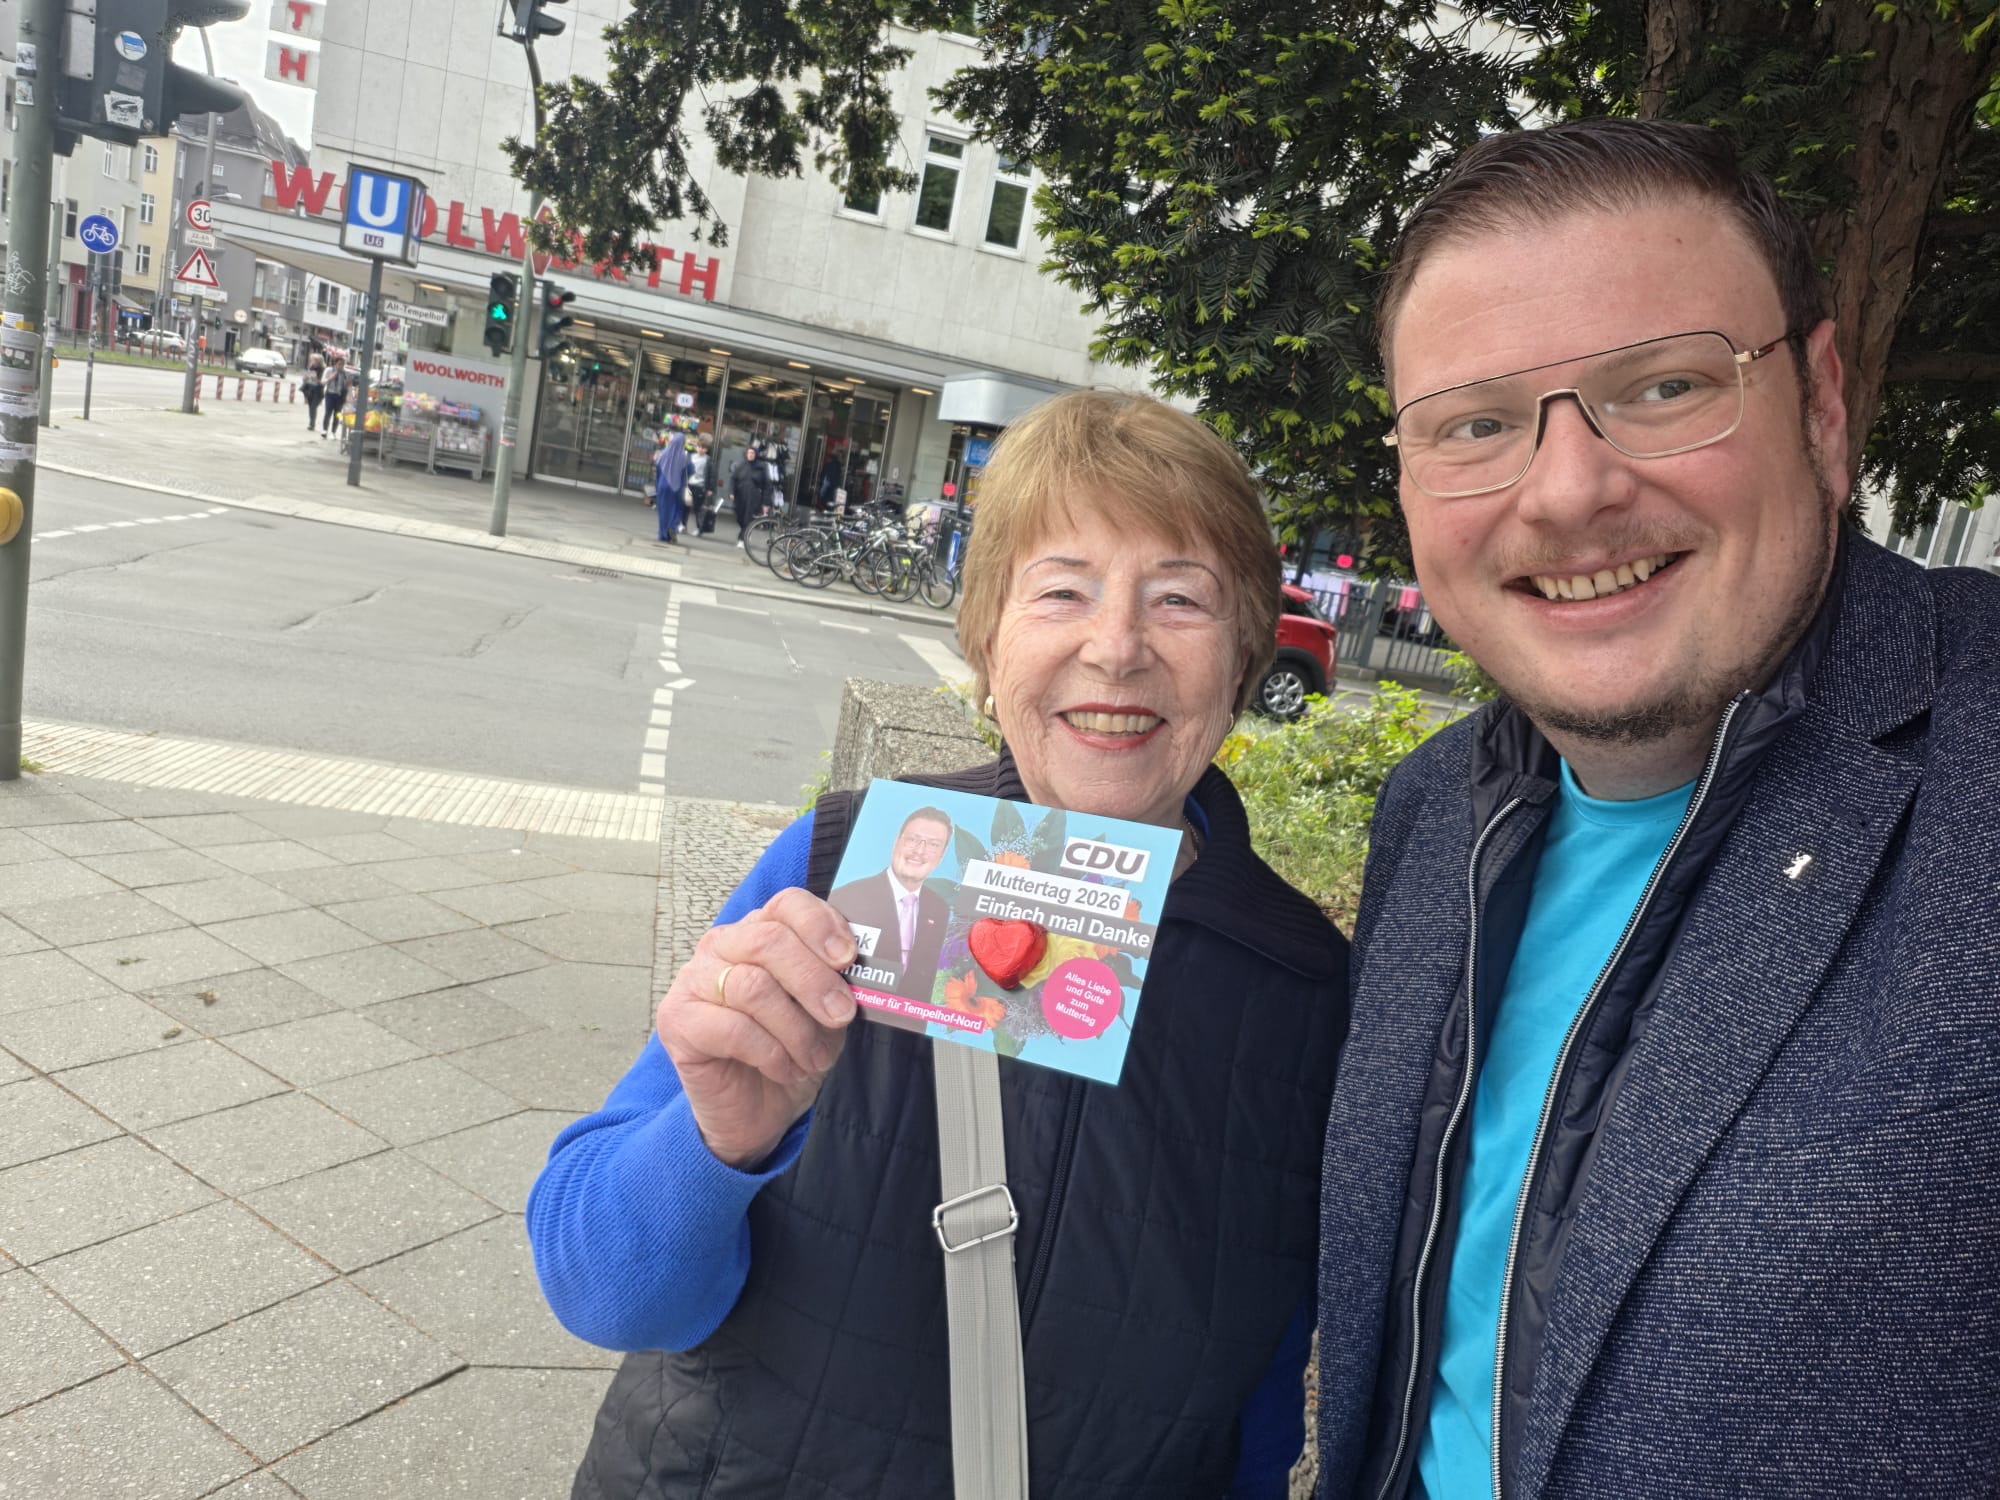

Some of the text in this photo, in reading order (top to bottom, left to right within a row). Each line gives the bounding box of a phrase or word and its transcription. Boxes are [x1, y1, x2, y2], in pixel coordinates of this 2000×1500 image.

[357, 174, 401, 227] U
[193, 207, 212, 223] 30
[365, 234, 383, 247] U6
[386, 301, 446, 323] Alt-Tempelhof
[413, 359, 505, 388] WOOLWORTH
[1065, 842, 1145, 876] CDU
[984, 868, 1121, 912] Muttertag 2026
[975, 894, 1151, 949] Einfach mal Danke
[842, 963, 896, 986] mann
[1064, 971, 1112, 996] Alles Liebe
[1065, 984, 1105, 1006] und Gute
[1070, 998, 1089, 1011] zum
[853, 991, 983, 1030] dneter für Tempelhof-Nord
[1055, 1001, 1096, 1028] Muttertag
